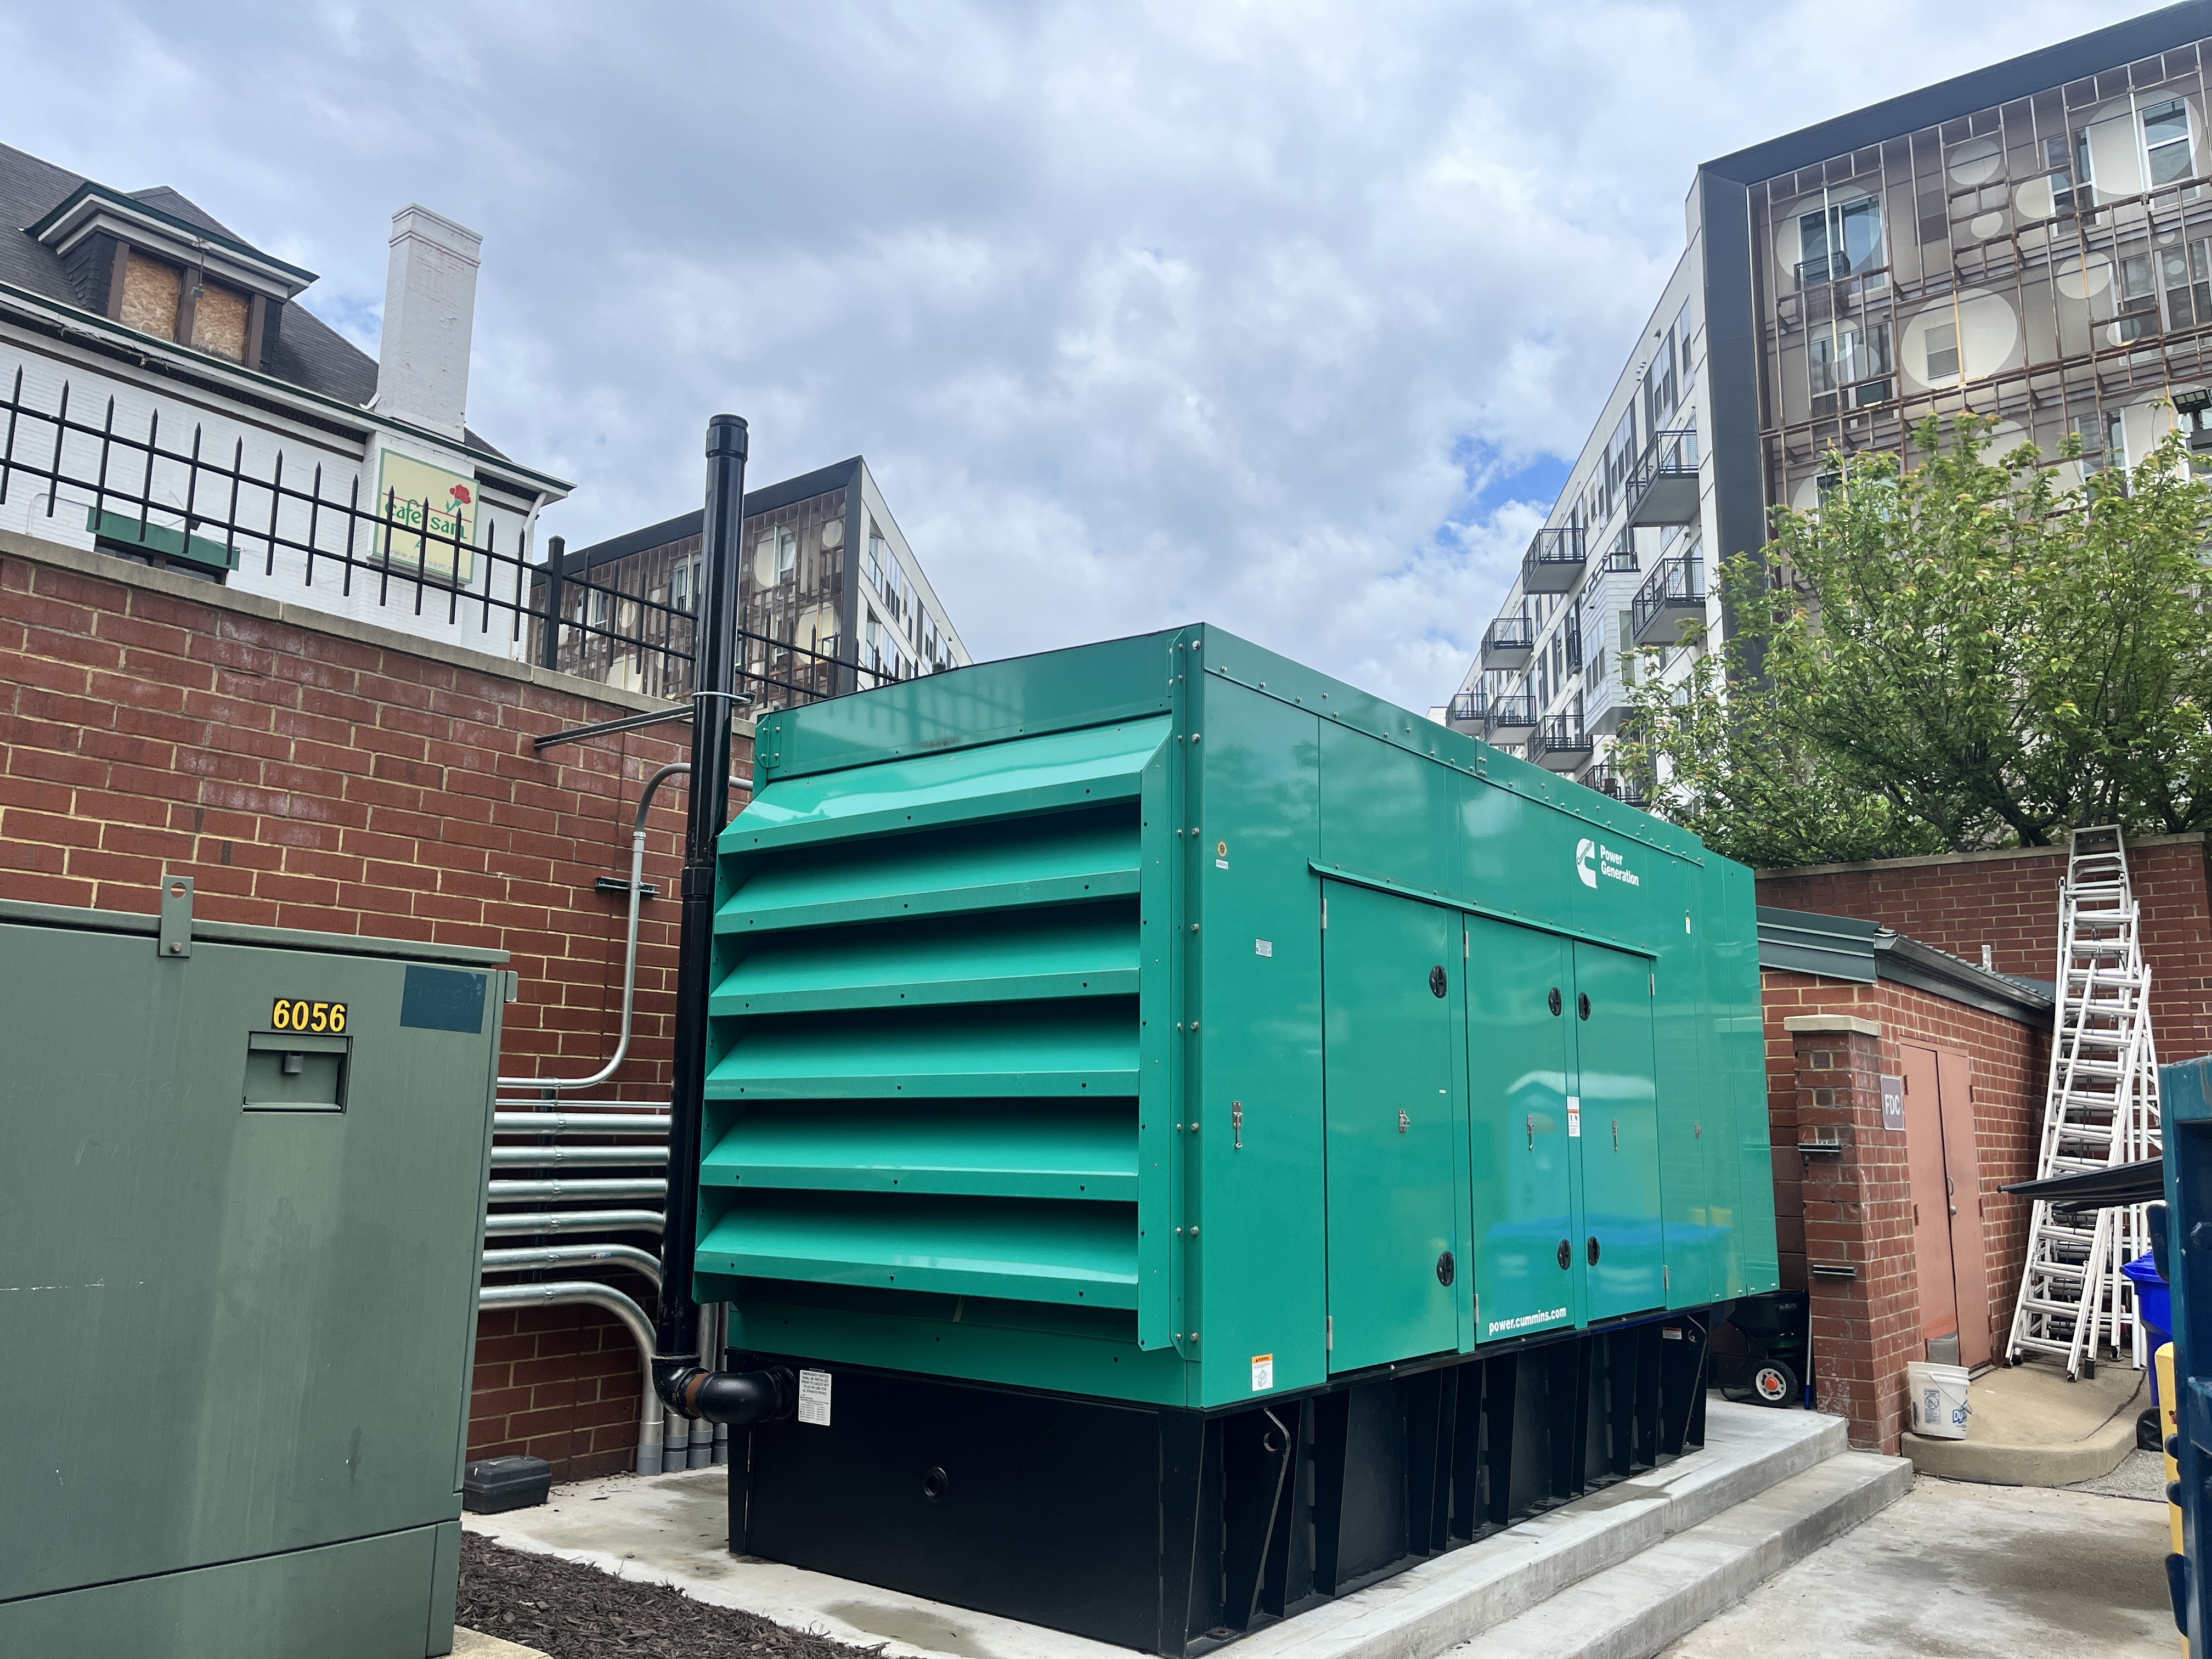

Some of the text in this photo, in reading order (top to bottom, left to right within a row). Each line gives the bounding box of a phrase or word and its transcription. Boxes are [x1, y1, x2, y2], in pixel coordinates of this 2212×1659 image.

[1600, 844, 1623, 865] Power
[1600, 860, 1639, 886] Generation
[273, 1000, 346, 1032] 6056
[1884, 1094, 1900, 1115] FDC
[1488, 1307, 1566, 1336] power.cummins.com
